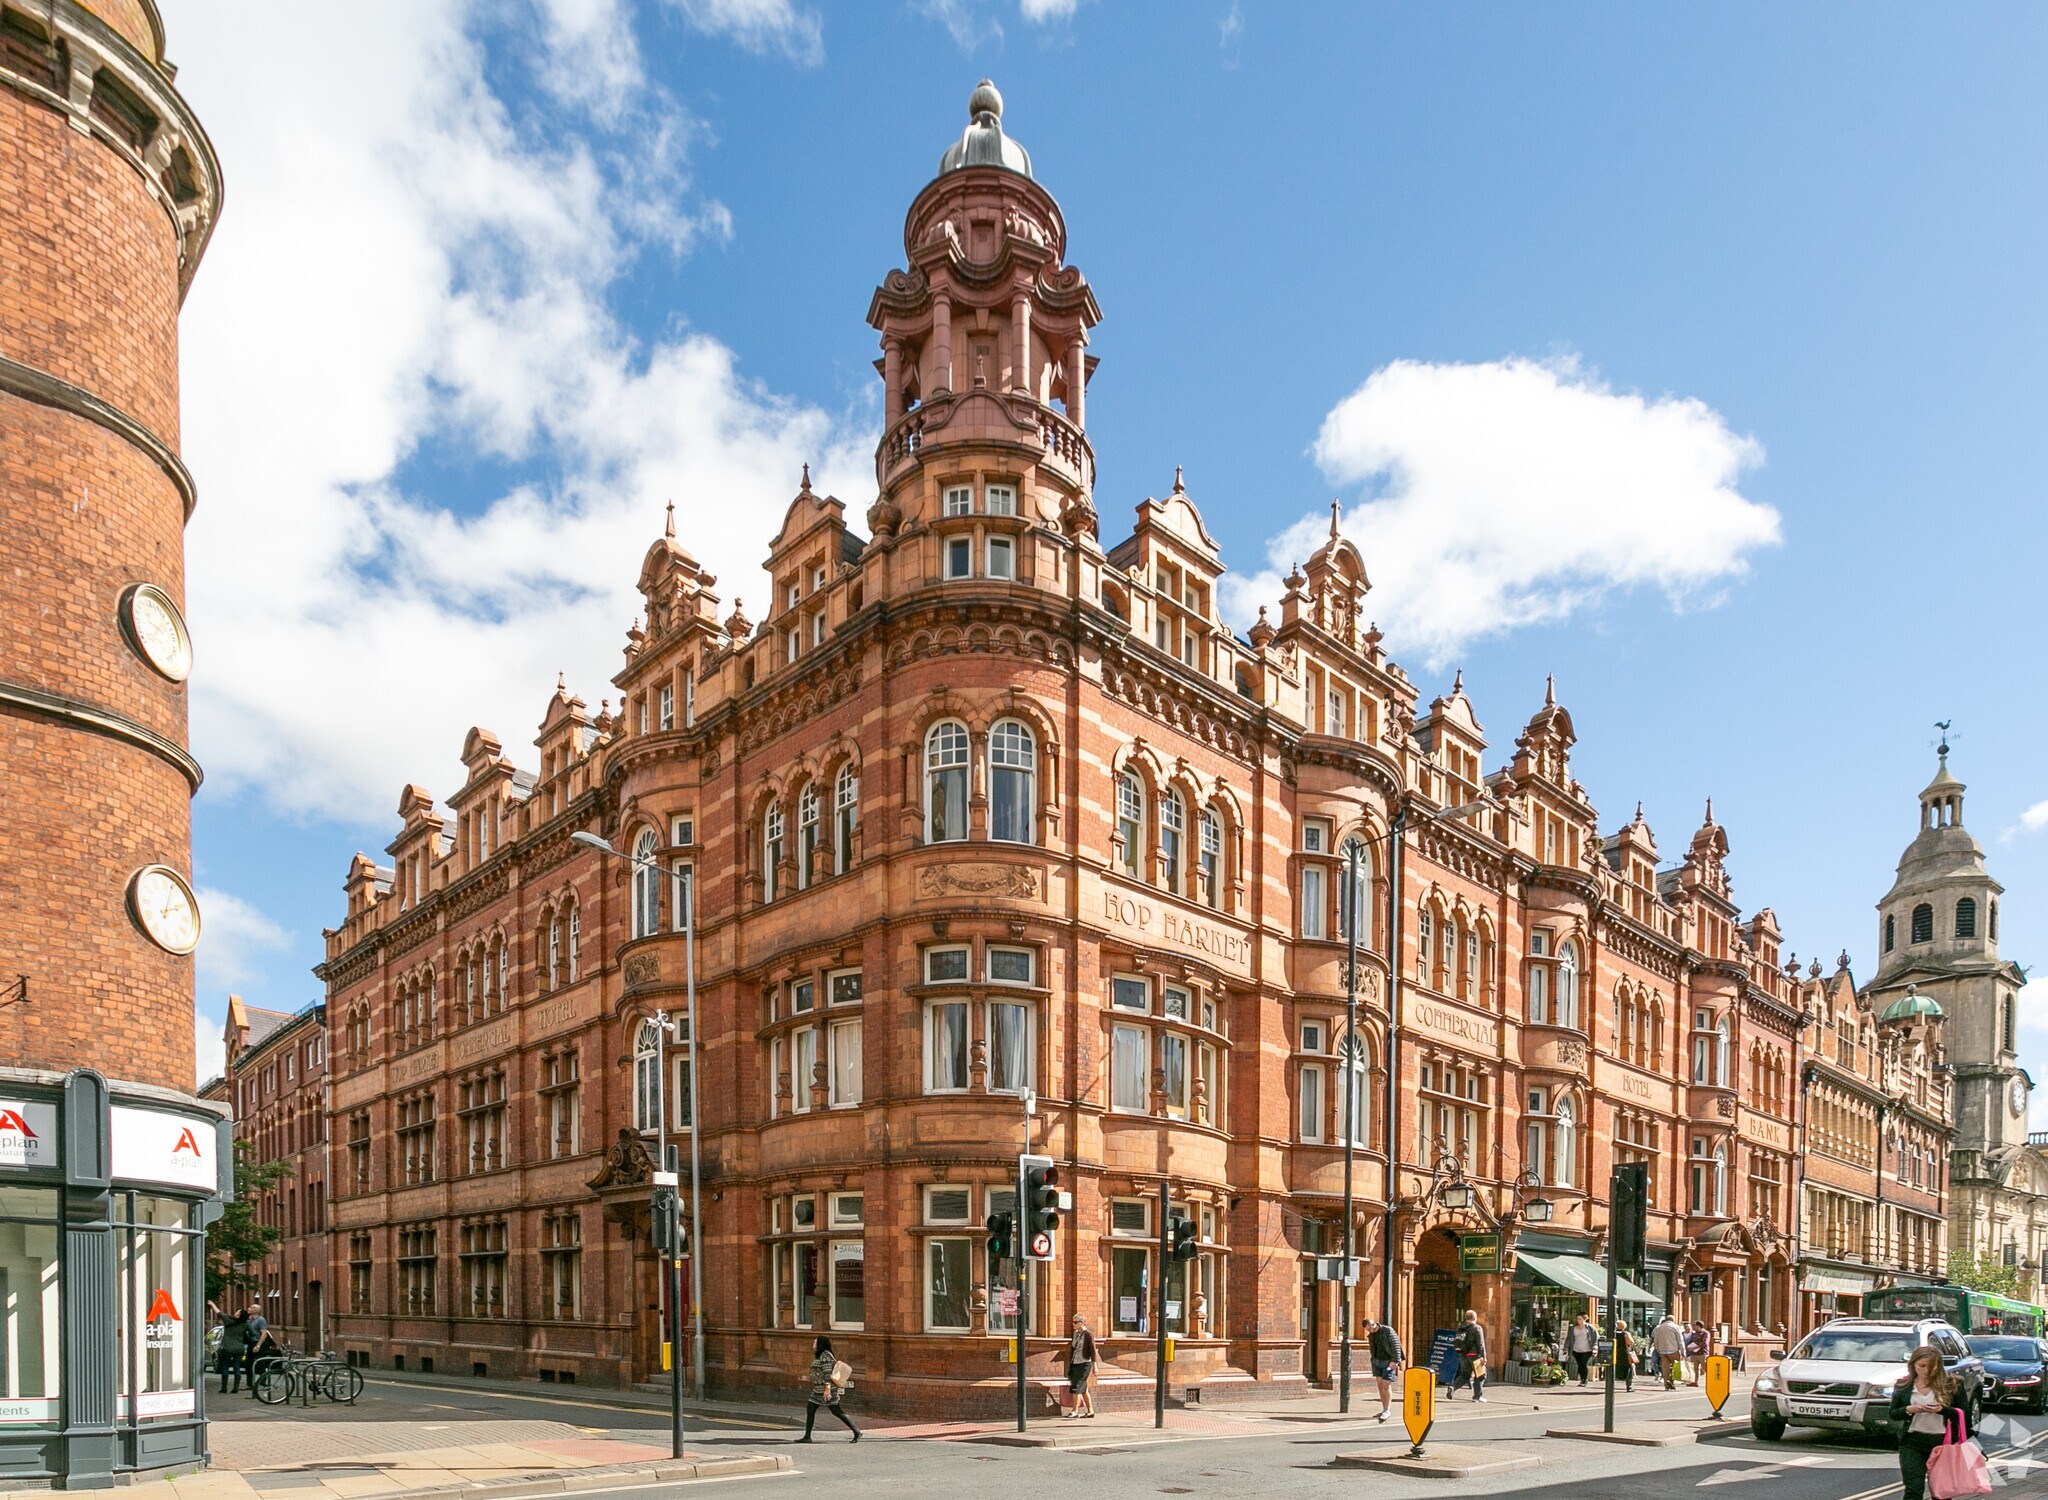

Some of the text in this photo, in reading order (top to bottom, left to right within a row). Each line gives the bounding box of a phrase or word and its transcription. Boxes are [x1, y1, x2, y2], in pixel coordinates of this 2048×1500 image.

[1104, 892, 1249, 965] HOP MARKET
[538, 1000, 576, 1030] HOTEL
[1415, 1003, 1499, 1048] COMMERCIAL
[1622, 1073, 1653, 1101] HOTEL
[1749, 1117, 1781, 1144] BANK
[1799, 1406, 1841, 1416] OY05 NFT
